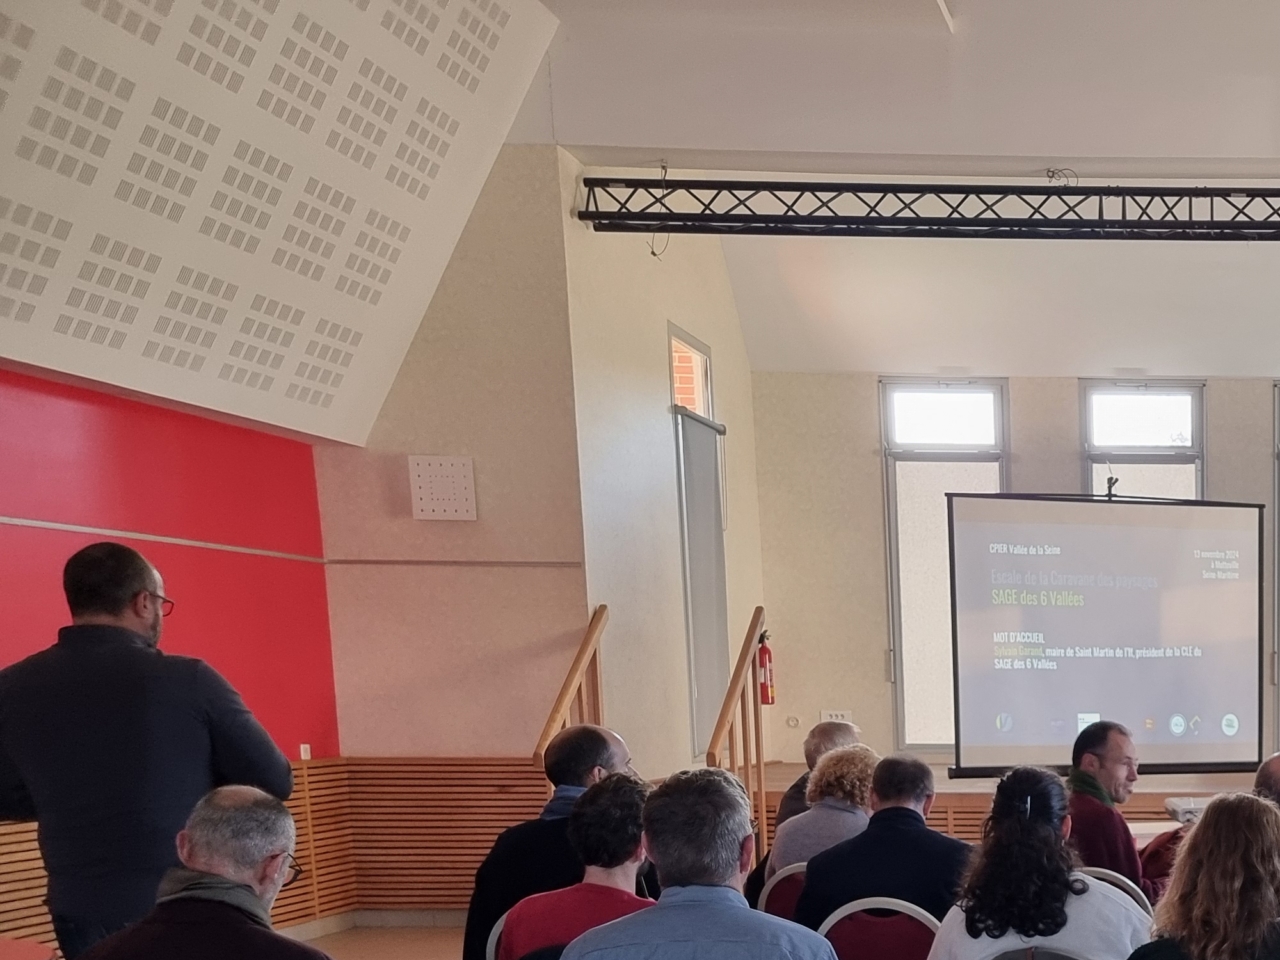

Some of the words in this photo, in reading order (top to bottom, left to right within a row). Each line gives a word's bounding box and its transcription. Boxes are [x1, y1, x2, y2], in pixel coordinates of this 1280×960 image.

[989, 543, 1008, 554] CPIER
[1008, 543, 1028, 555] Vallée
[1029, 545, 1037, 555] de
[1037, 544, 1043, 555] la
[1044, 544, 1061, 555] Seine
[1201, 550, 1225, 559] novembre
[1226, 550, 1239, 559] 2024
[991, 569, 1022, 585] Escale
[1024, 571, 1037, 585] de
[1039, 571, 1048, 585] la
[1050, 570, 1095, 586] Caravane
[1097, 571, 1113, 587] des
[1116, 573, 1158, 590] paysages
[991, 589, 1018, 605] SAGE
[1020, 590, 1038, 606] des
[1041, 590, 1047, 605] 6
[1050, 590, 1085, 606] Vallées
[993, 632, 1008, 643] MOT
[1010, 632, 1045, 644] D'ACCUEIL
[1045, 647, 1065, 657] maire
[1066, 646, 1074, 657] de
[1075, 646, 1092, 657] Saint
[1093, 646, 1114, 658] Martin
[1115, 647, 1123, 658] de
[1135, 647, 1164, 660] président
[1165, 646, 1173, 657] de
[1174, 646, 1180, 657] la
[1181, 645, 1193, 657] CLE
[1194, 645, 1202, 657] du
[994, 658, 1013, 669] SAGE
[1013, 658, 1025, 669] des
[1026, 658, 1031, 669] 6
[1032, 658, 1058, 670] Vallées
